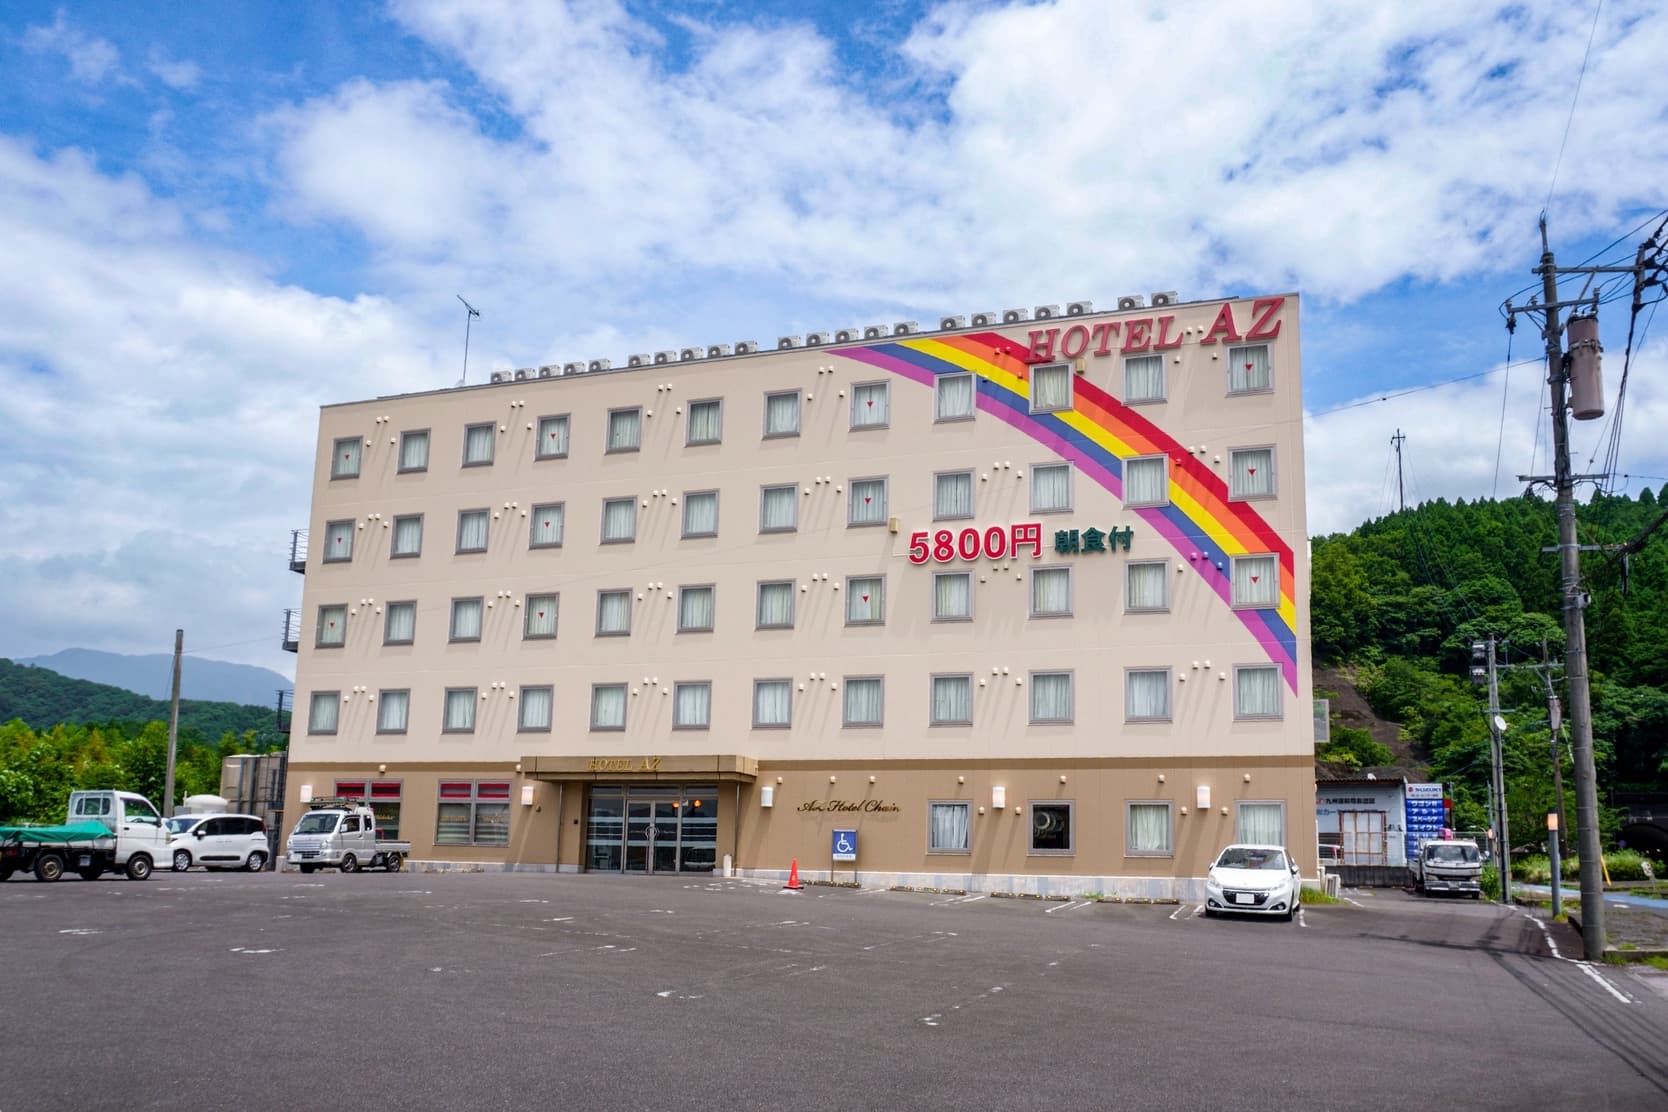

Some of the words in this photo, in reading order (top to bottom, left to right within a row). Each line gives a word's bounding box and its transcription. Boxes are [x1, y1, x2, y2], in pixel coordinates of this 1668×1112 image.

[1024, 315, 1184, 364] HOTEL
[1200, 297, 1285, 345] AZ
[908, 522, 1043, 565] 5800円
[1054, 525, 1134, 555] 朝食付
[588, 759, 632, 770] HOTEL
[640, 757, 663, 770] AZ
[827, 799, 866, 812] Hotel
[864, 799, 900, 812] Chain
